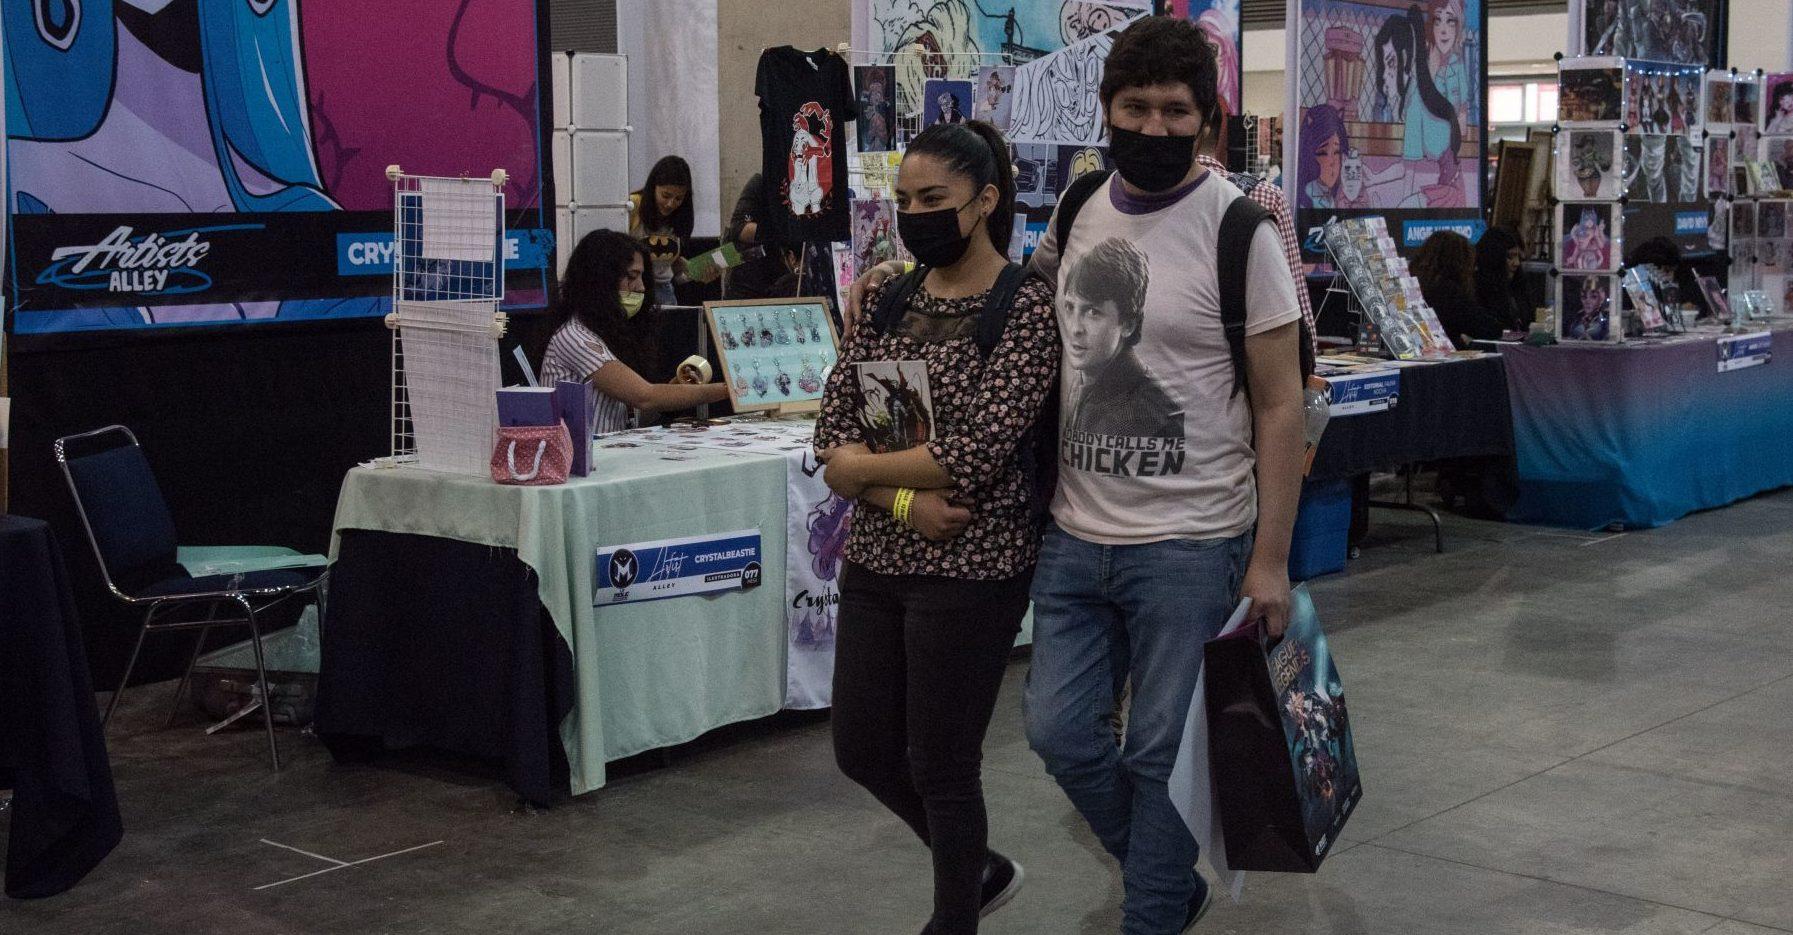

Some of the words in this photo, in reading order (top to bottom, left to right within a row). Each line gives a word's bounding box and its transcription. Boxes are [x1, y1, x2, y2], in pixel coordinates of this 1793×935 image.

[51, 225, 211, 275] Artists
[109, 269, 169, 292] ALLEY
[1106, 435, 1157, 452] CALLS
[1161, 437, 1185, 451] ME
[1061, 440, 1186, 477] CHICKEN
[694, 547, 756, 564] CRYSTALBEASTIE
[744, 569, 759, 579] 077
[653, 582, 676, 591] ALLEY
